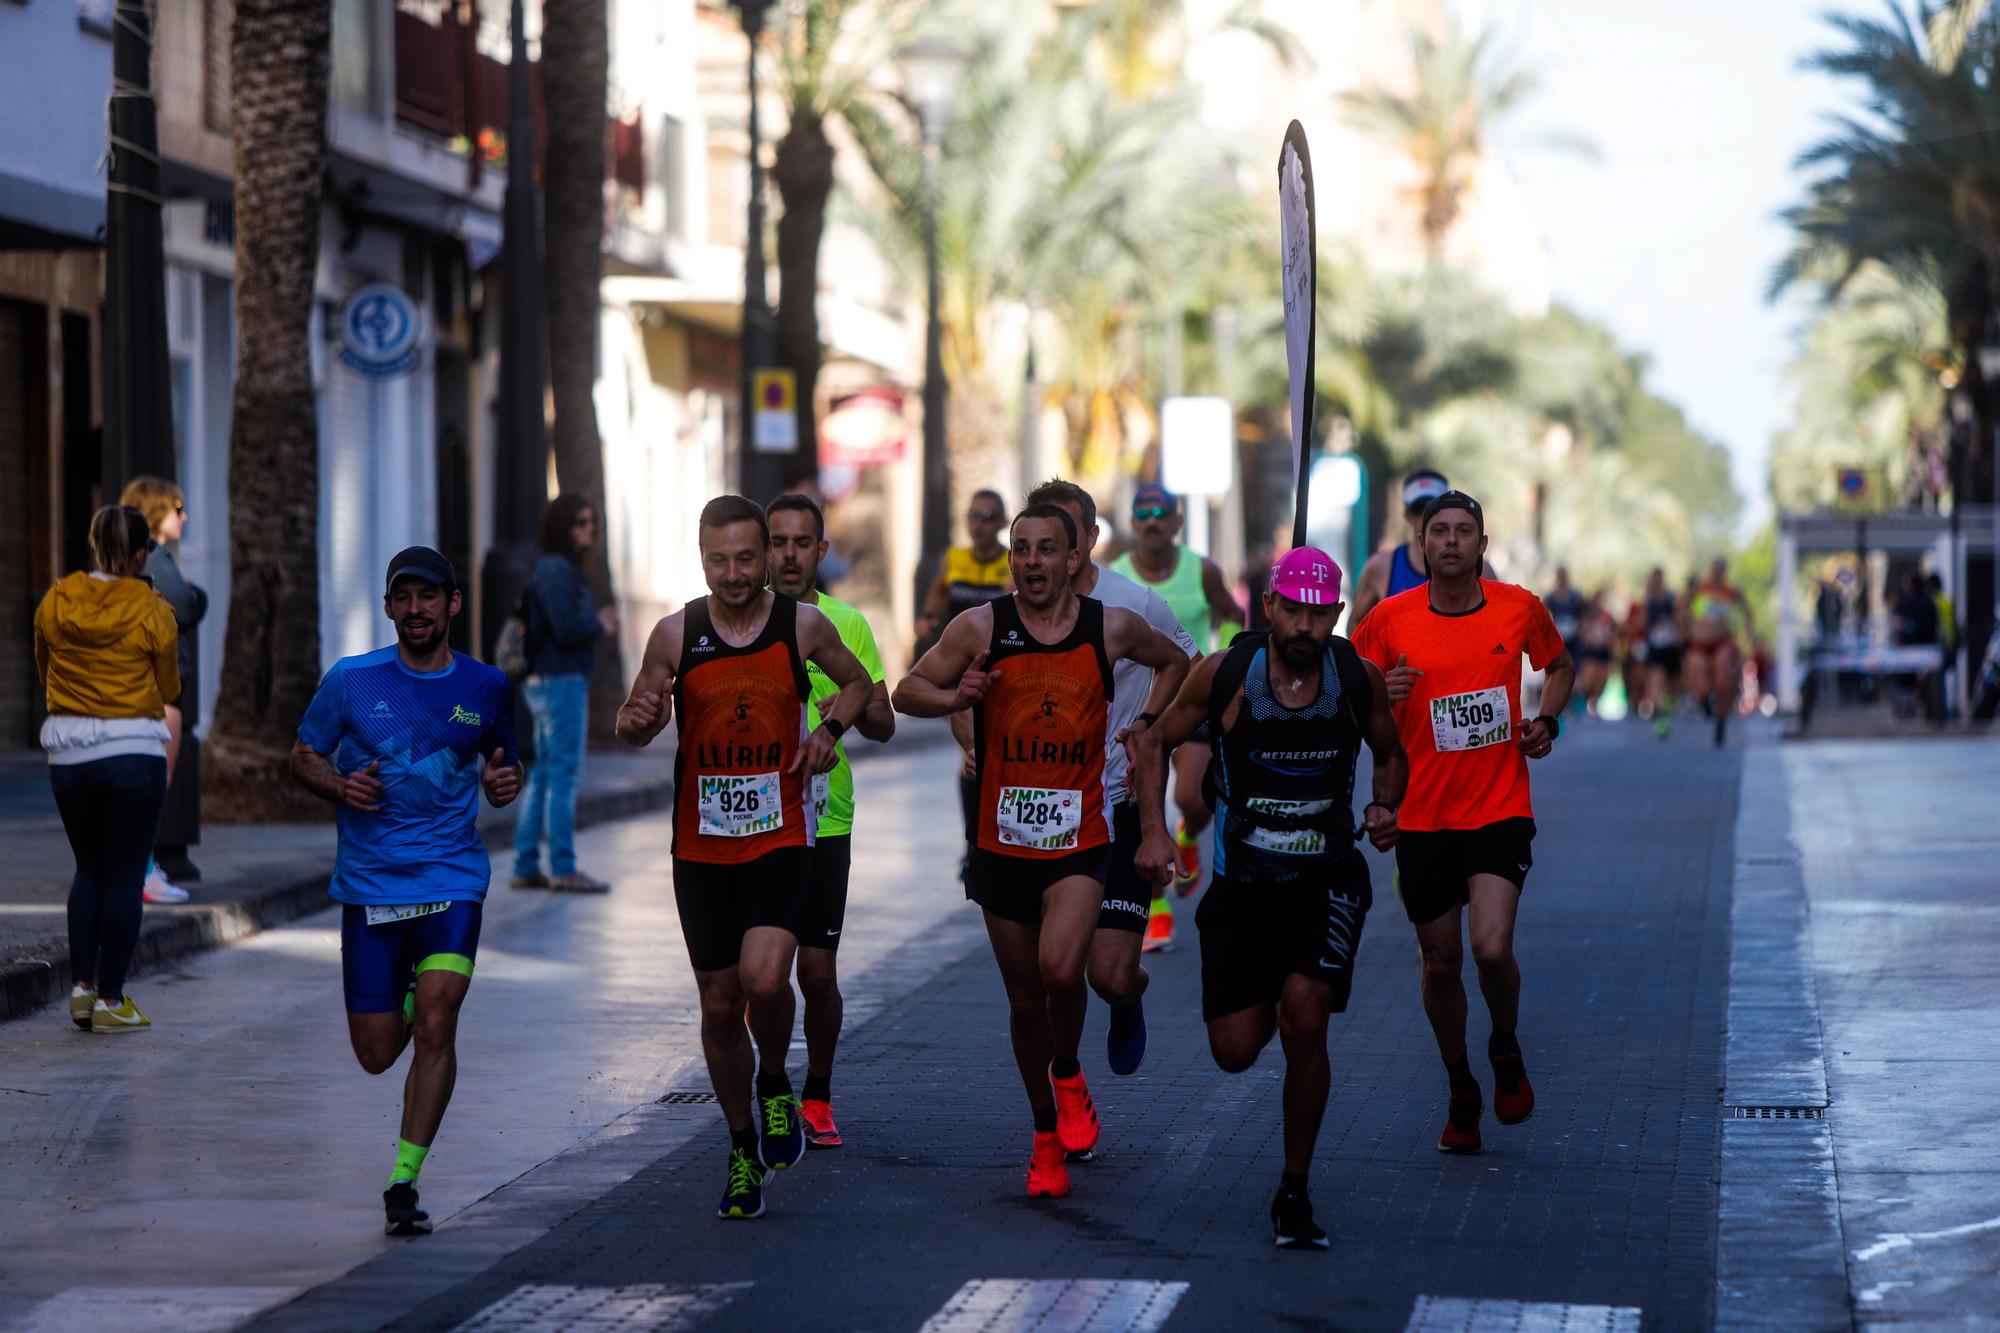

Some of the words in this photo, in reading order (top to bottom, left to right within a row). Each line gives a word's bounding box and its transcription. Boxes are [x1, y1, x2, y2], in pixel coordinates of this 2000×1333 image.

[1000, 639, 1024, 647] VIATOR
[1449, 703, 1494, 728] 1309
[698, 740, 781, 768] LLÍRIA
[1003, 736, 1086, 765] LLÍRIA
[1261, 750, 1338, 760] METAESPORT
[720, 790, 760, 813] 926
[1016, 801, 1063, 826] 1284
[1101, 899, 1149, 918] ARMOU
